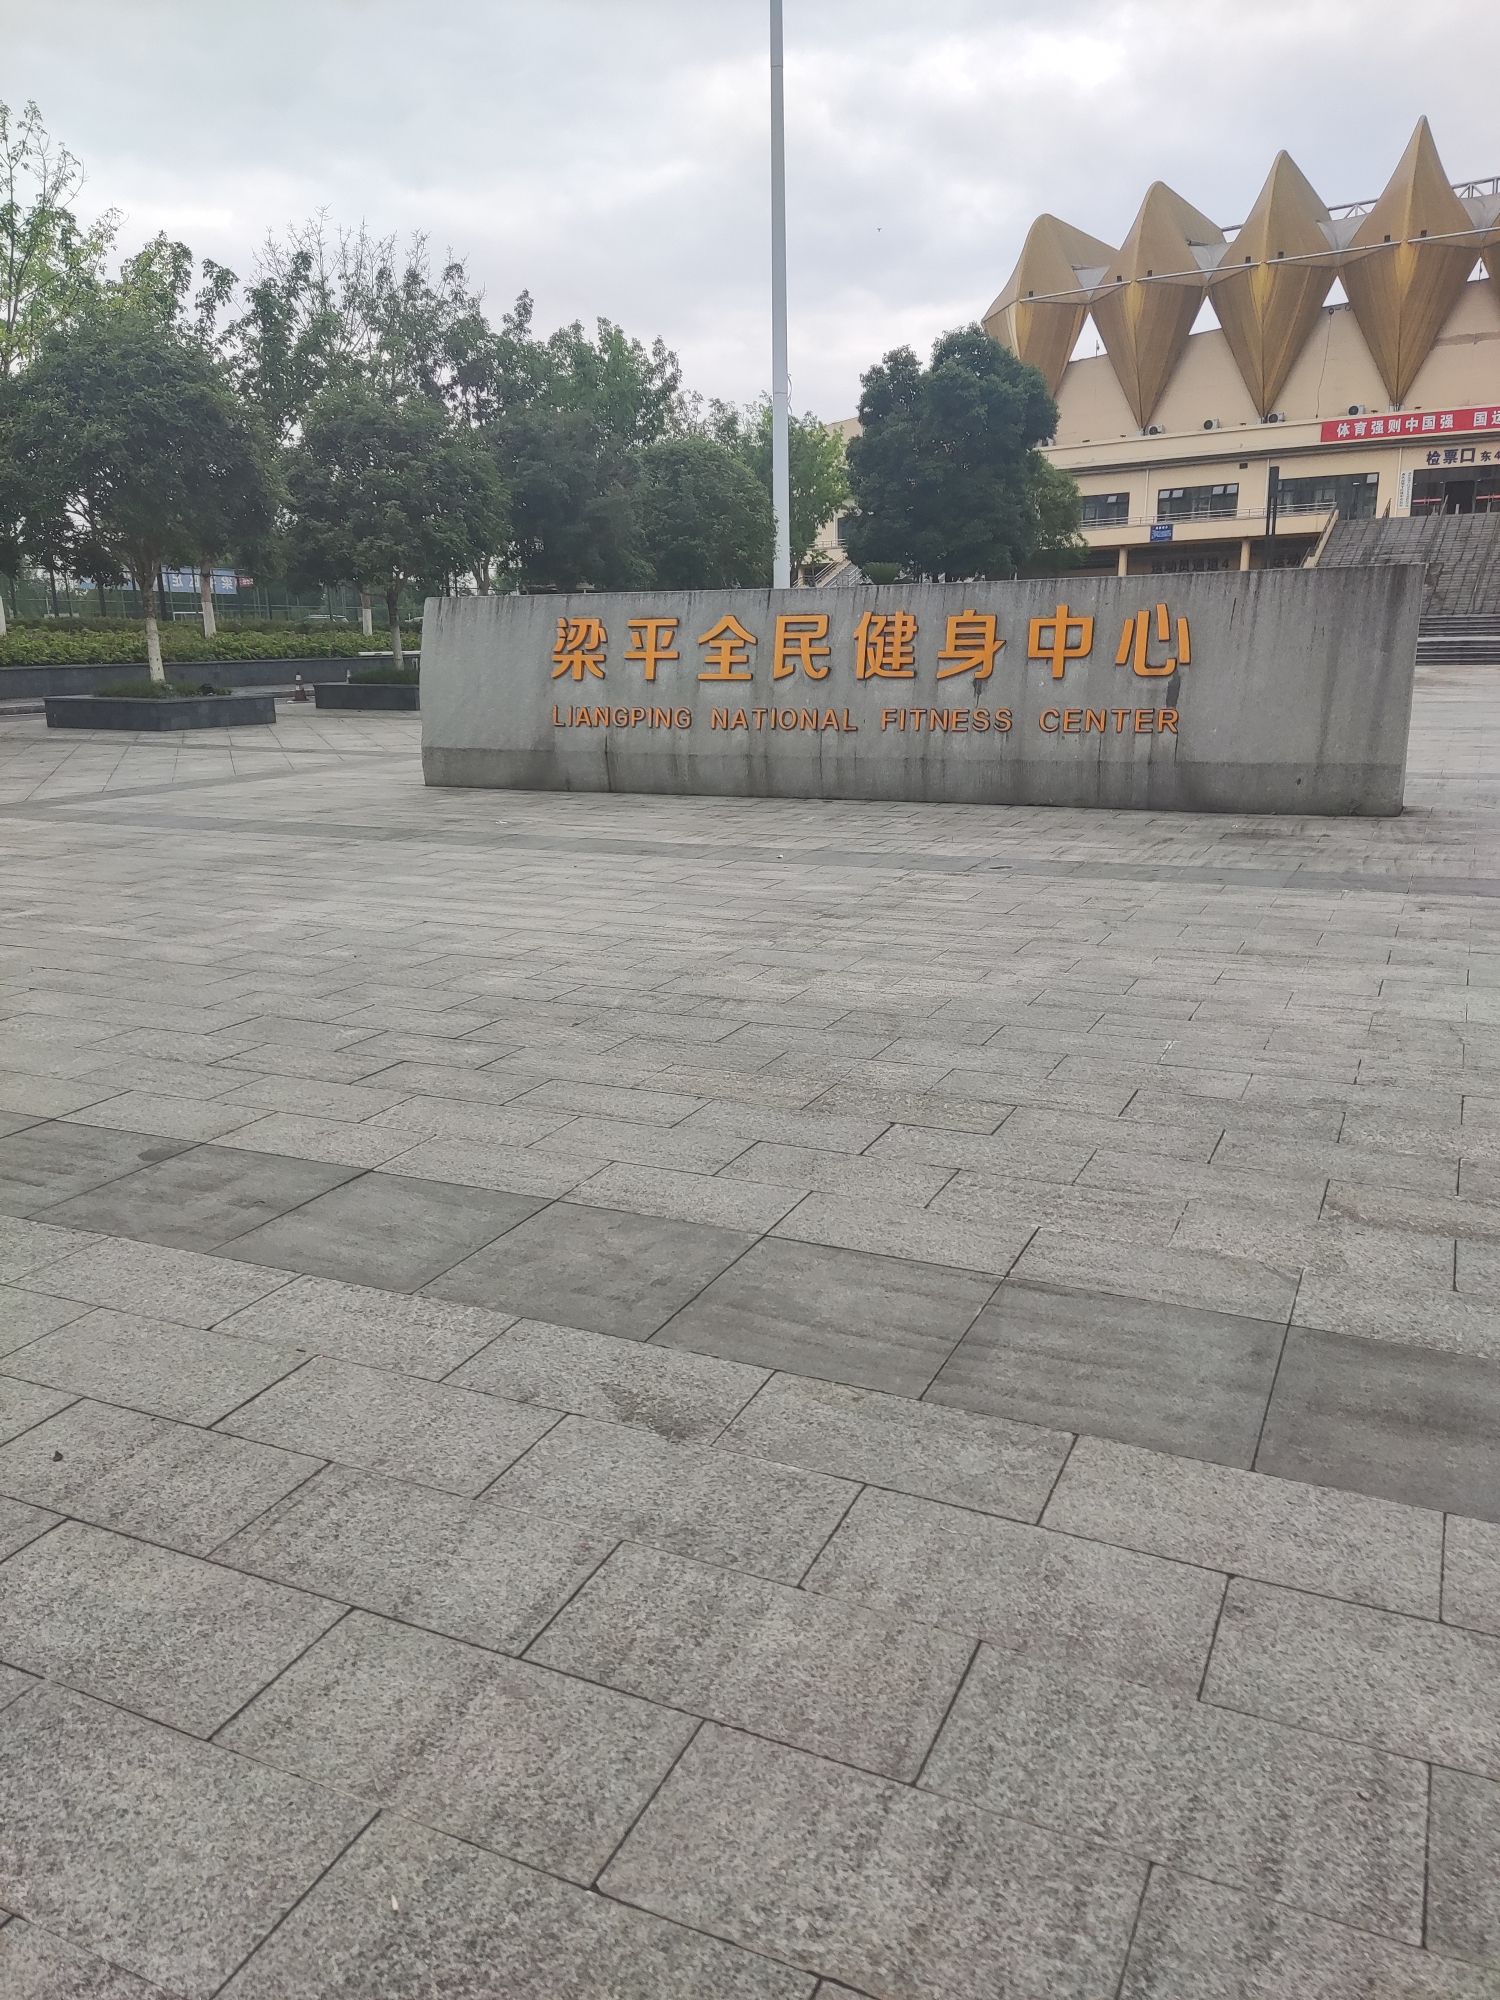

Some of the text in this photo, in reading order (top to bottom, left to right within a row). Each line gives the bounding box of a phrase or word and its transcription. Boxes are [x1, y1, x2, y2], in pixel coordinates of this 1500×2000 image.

[1337, 414, 1454, 438] 体育强则中国强
[551, 603, 1192, 681] 梁平全民健身中心
[552, 705, 1180, 734] LIANGPING NATIONAL FITNESS CENTER
